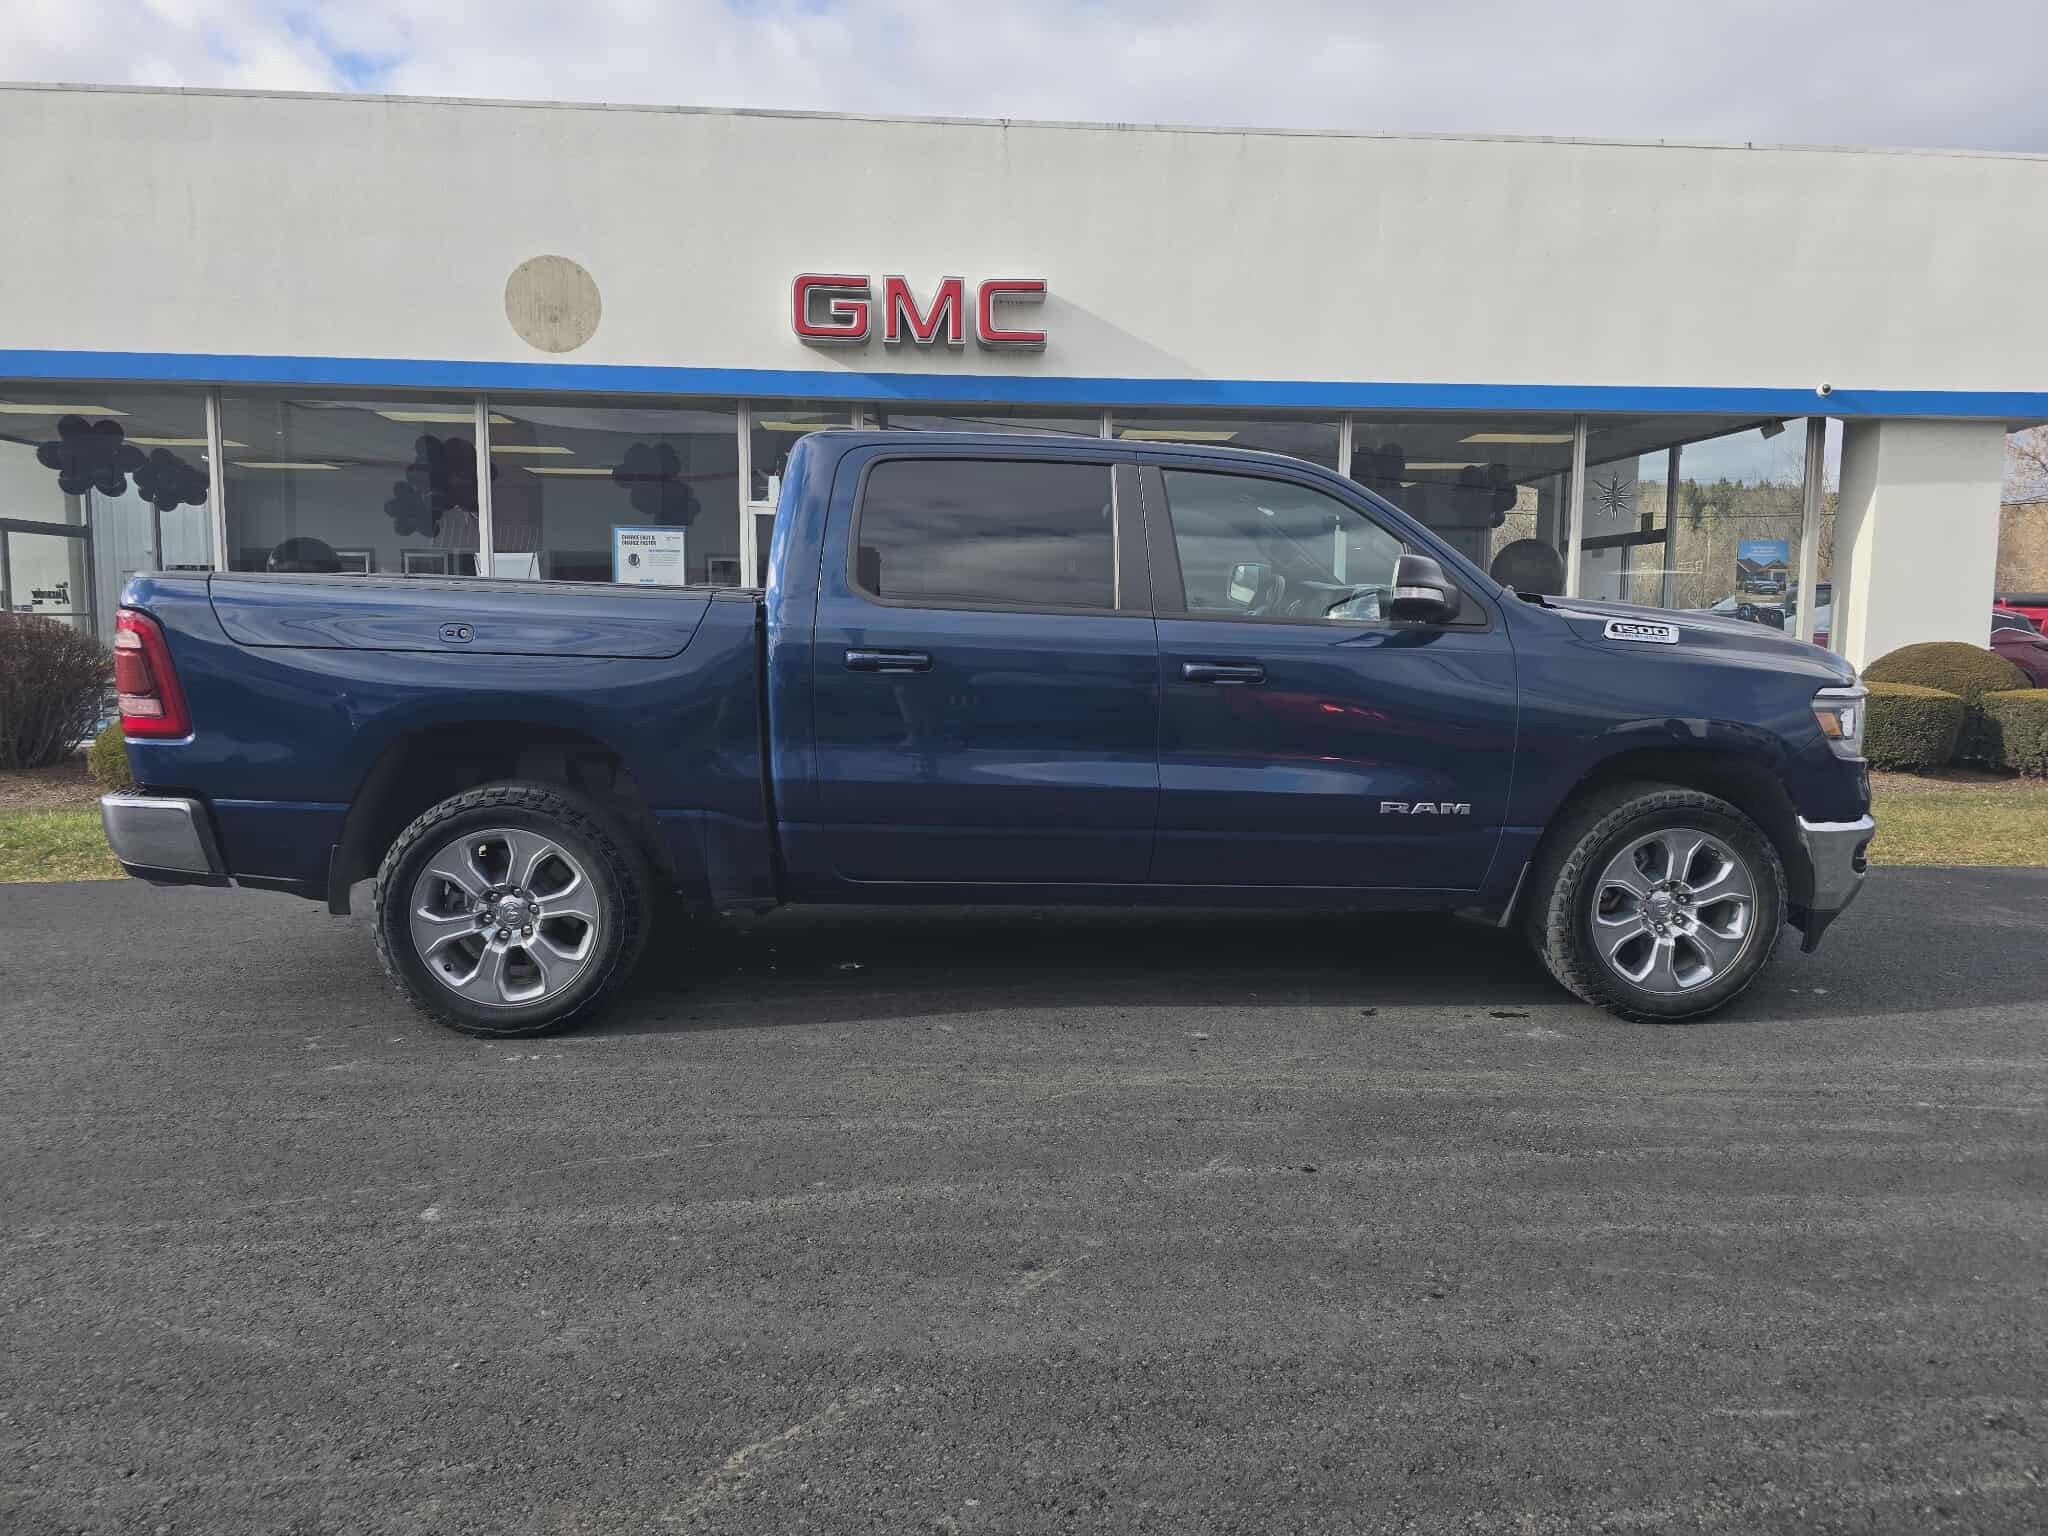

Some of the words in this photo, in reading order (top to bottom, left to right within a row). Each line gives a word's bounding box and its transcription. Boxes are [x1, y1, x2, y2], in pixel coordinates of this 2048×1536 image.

[791, 273, 1048, 346] GMC
[1613, 623, 1669, 636] 1500
[1380, 801, 1472, 815] RAM
